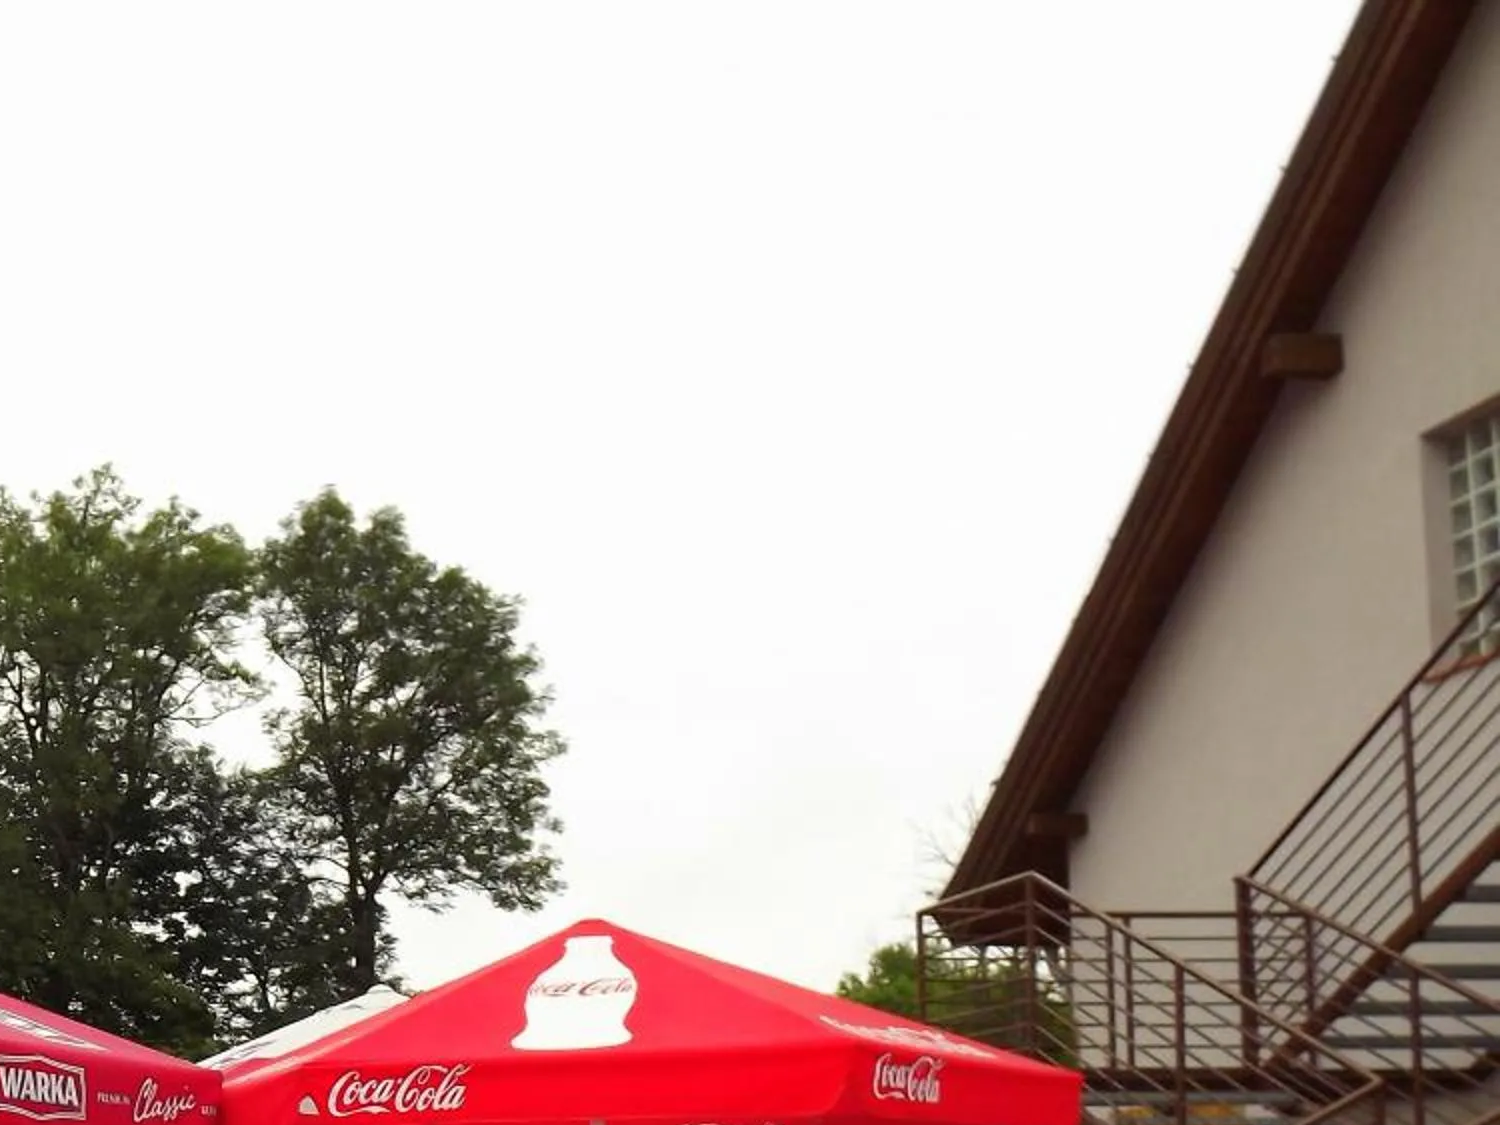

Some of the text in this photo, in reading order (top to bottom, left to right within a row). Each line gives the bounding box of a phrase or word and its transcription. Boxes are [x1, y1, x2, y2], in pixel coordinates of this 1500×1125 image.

[0, 1066, 79, 1106] WARKA
[133, 1077, 197, 1122] Classic
[327, 1063, 474, 1117] Coca-Cola
